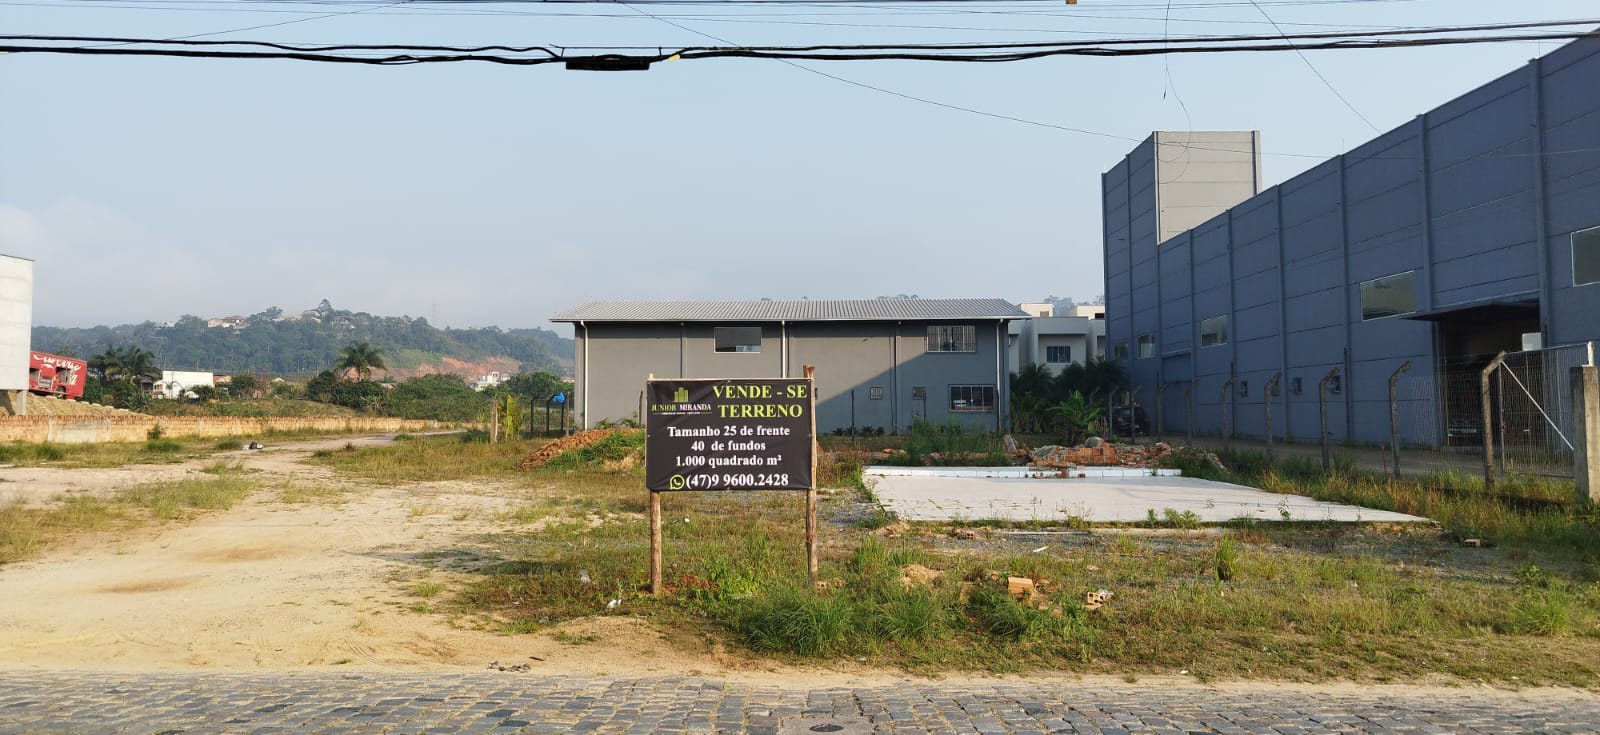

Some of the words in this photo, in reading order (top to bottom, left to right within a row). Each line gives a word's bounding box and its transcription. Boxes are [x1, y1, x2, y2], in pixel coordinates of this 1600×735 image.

[712, 385, 772, 399] VENDE
[786, 384, 808, 399] SE
[679, 403, 712, 411] MIRANDA
[717, 404, 803, 418] TERRENO
[667, 426, 720, 437] Tamanho
[723, 426, 737, 436] 25
[740, 425, 754, 436] de
[756, 425, 791, 436] frente
[691, 441, 705, 451] 40
[711, 441, 725, 451] de
[727, 440, 766, 451] fundos
[675, 456, 705, 467] 1.000
[708, 455, 764, 468] quadrado
[766, 454, 782, 466] m²
[686, 474, 719, 489] (47)9
[723, 474, 789, 487] 9600.2428
